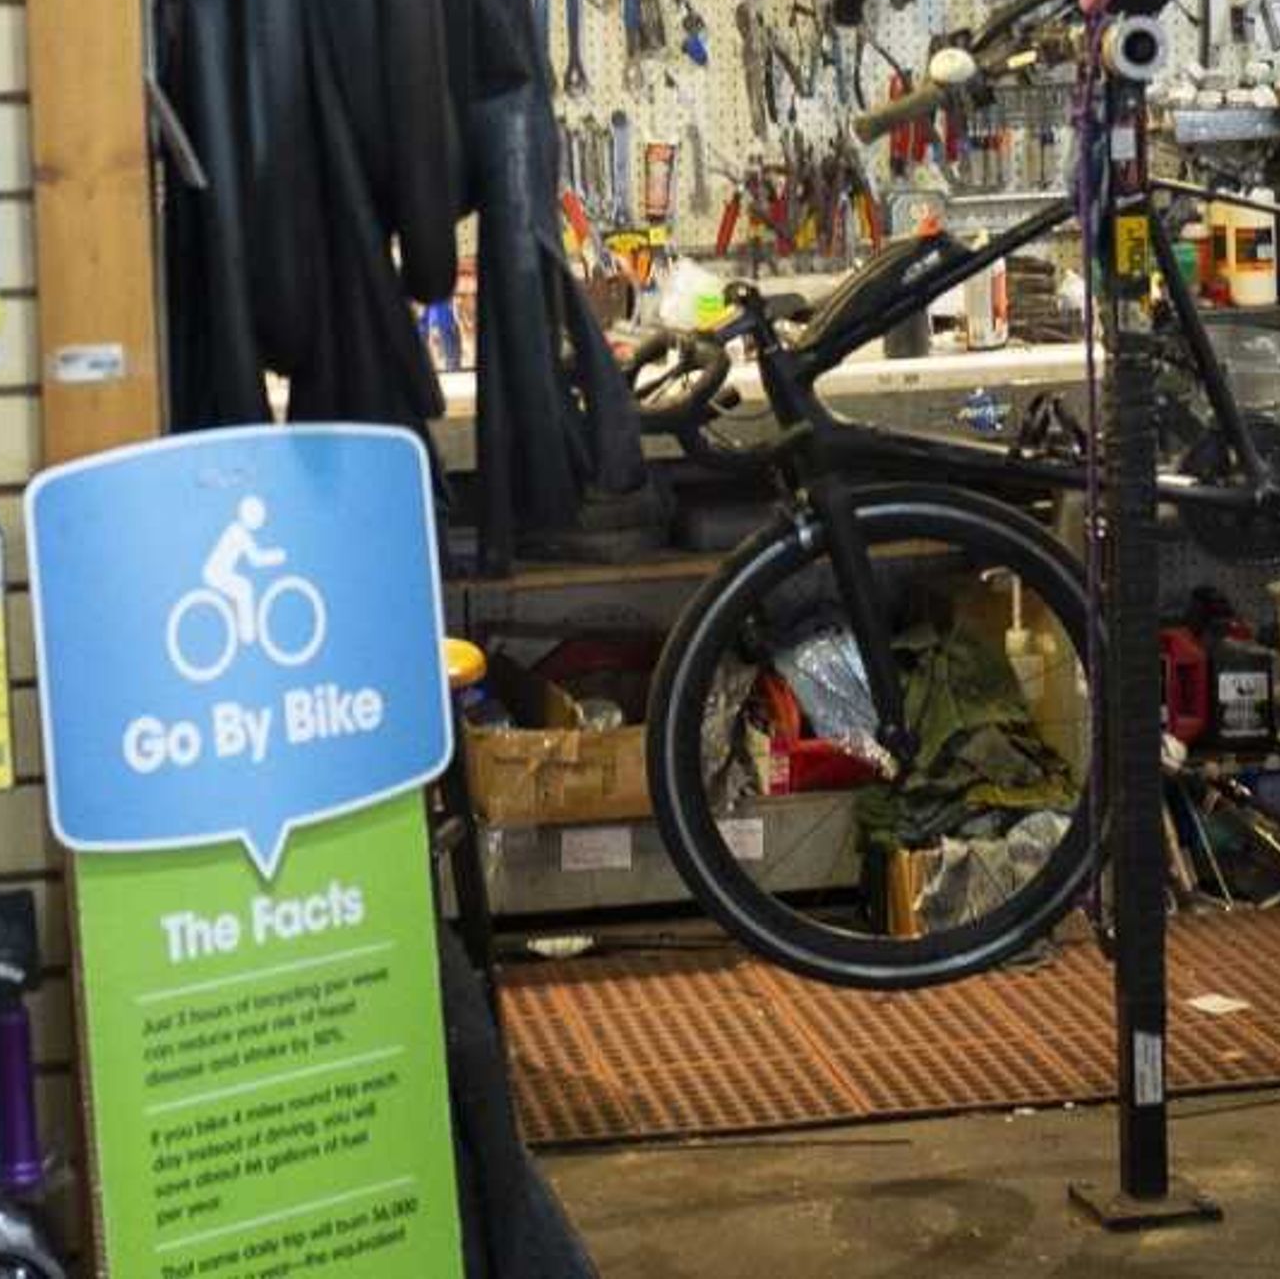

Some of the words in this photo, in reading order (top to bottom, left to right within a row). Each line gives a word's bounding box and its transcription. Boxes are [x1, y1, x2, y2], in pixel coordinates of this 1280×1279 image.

[122, 715, 202, 774] Go
[212, 703, 271, 763] By
[284, 684, 384, 744] Bike
[160, 909, 241, 964] The
[251, 881, 366, 945] Facts
